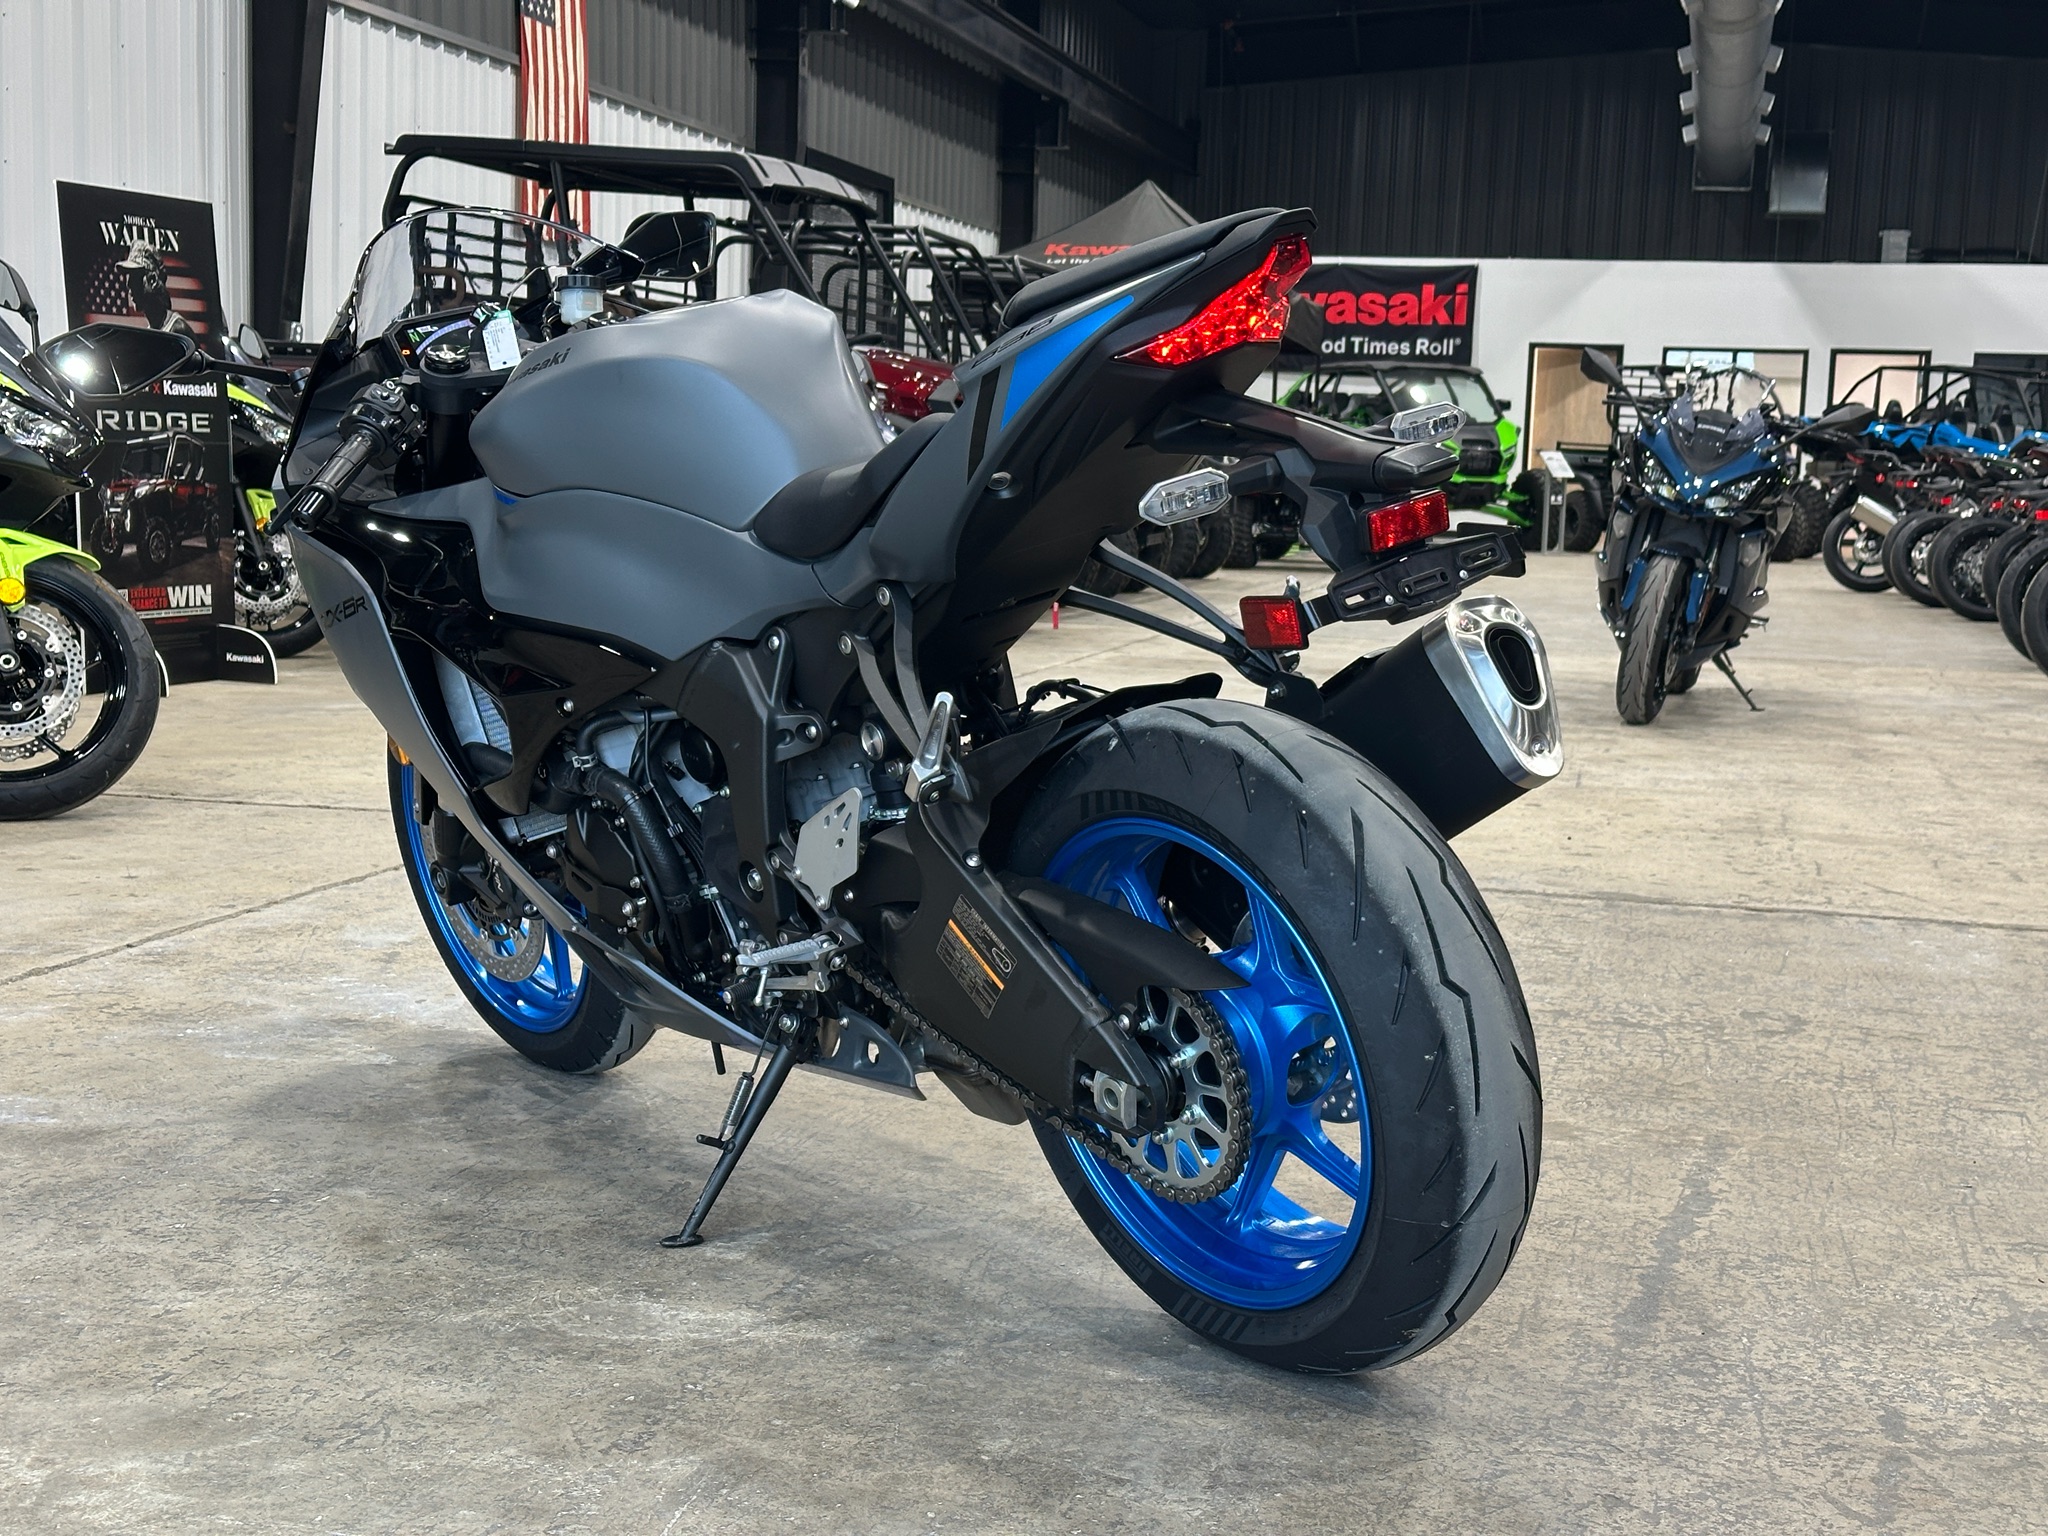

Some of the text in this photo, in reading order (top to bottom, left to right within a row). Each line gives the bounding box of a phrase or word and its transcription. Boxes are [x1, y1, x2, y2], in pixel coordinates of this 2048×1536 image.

[123, 214, 156, 228] MORGAN
[1320, 336, 1347, 355] od
[1350, 336, 1411, 356] Times
[505, 347, 572, 387] asaki
[162, 380, 218, 398] Kawasaki
[96, 408, 211, 433] RIDGE
[167, 583, 212, 609] WIN
[321, 595, 369, 628] X-6R
[225, 652, 265, 665] Kawasaki
